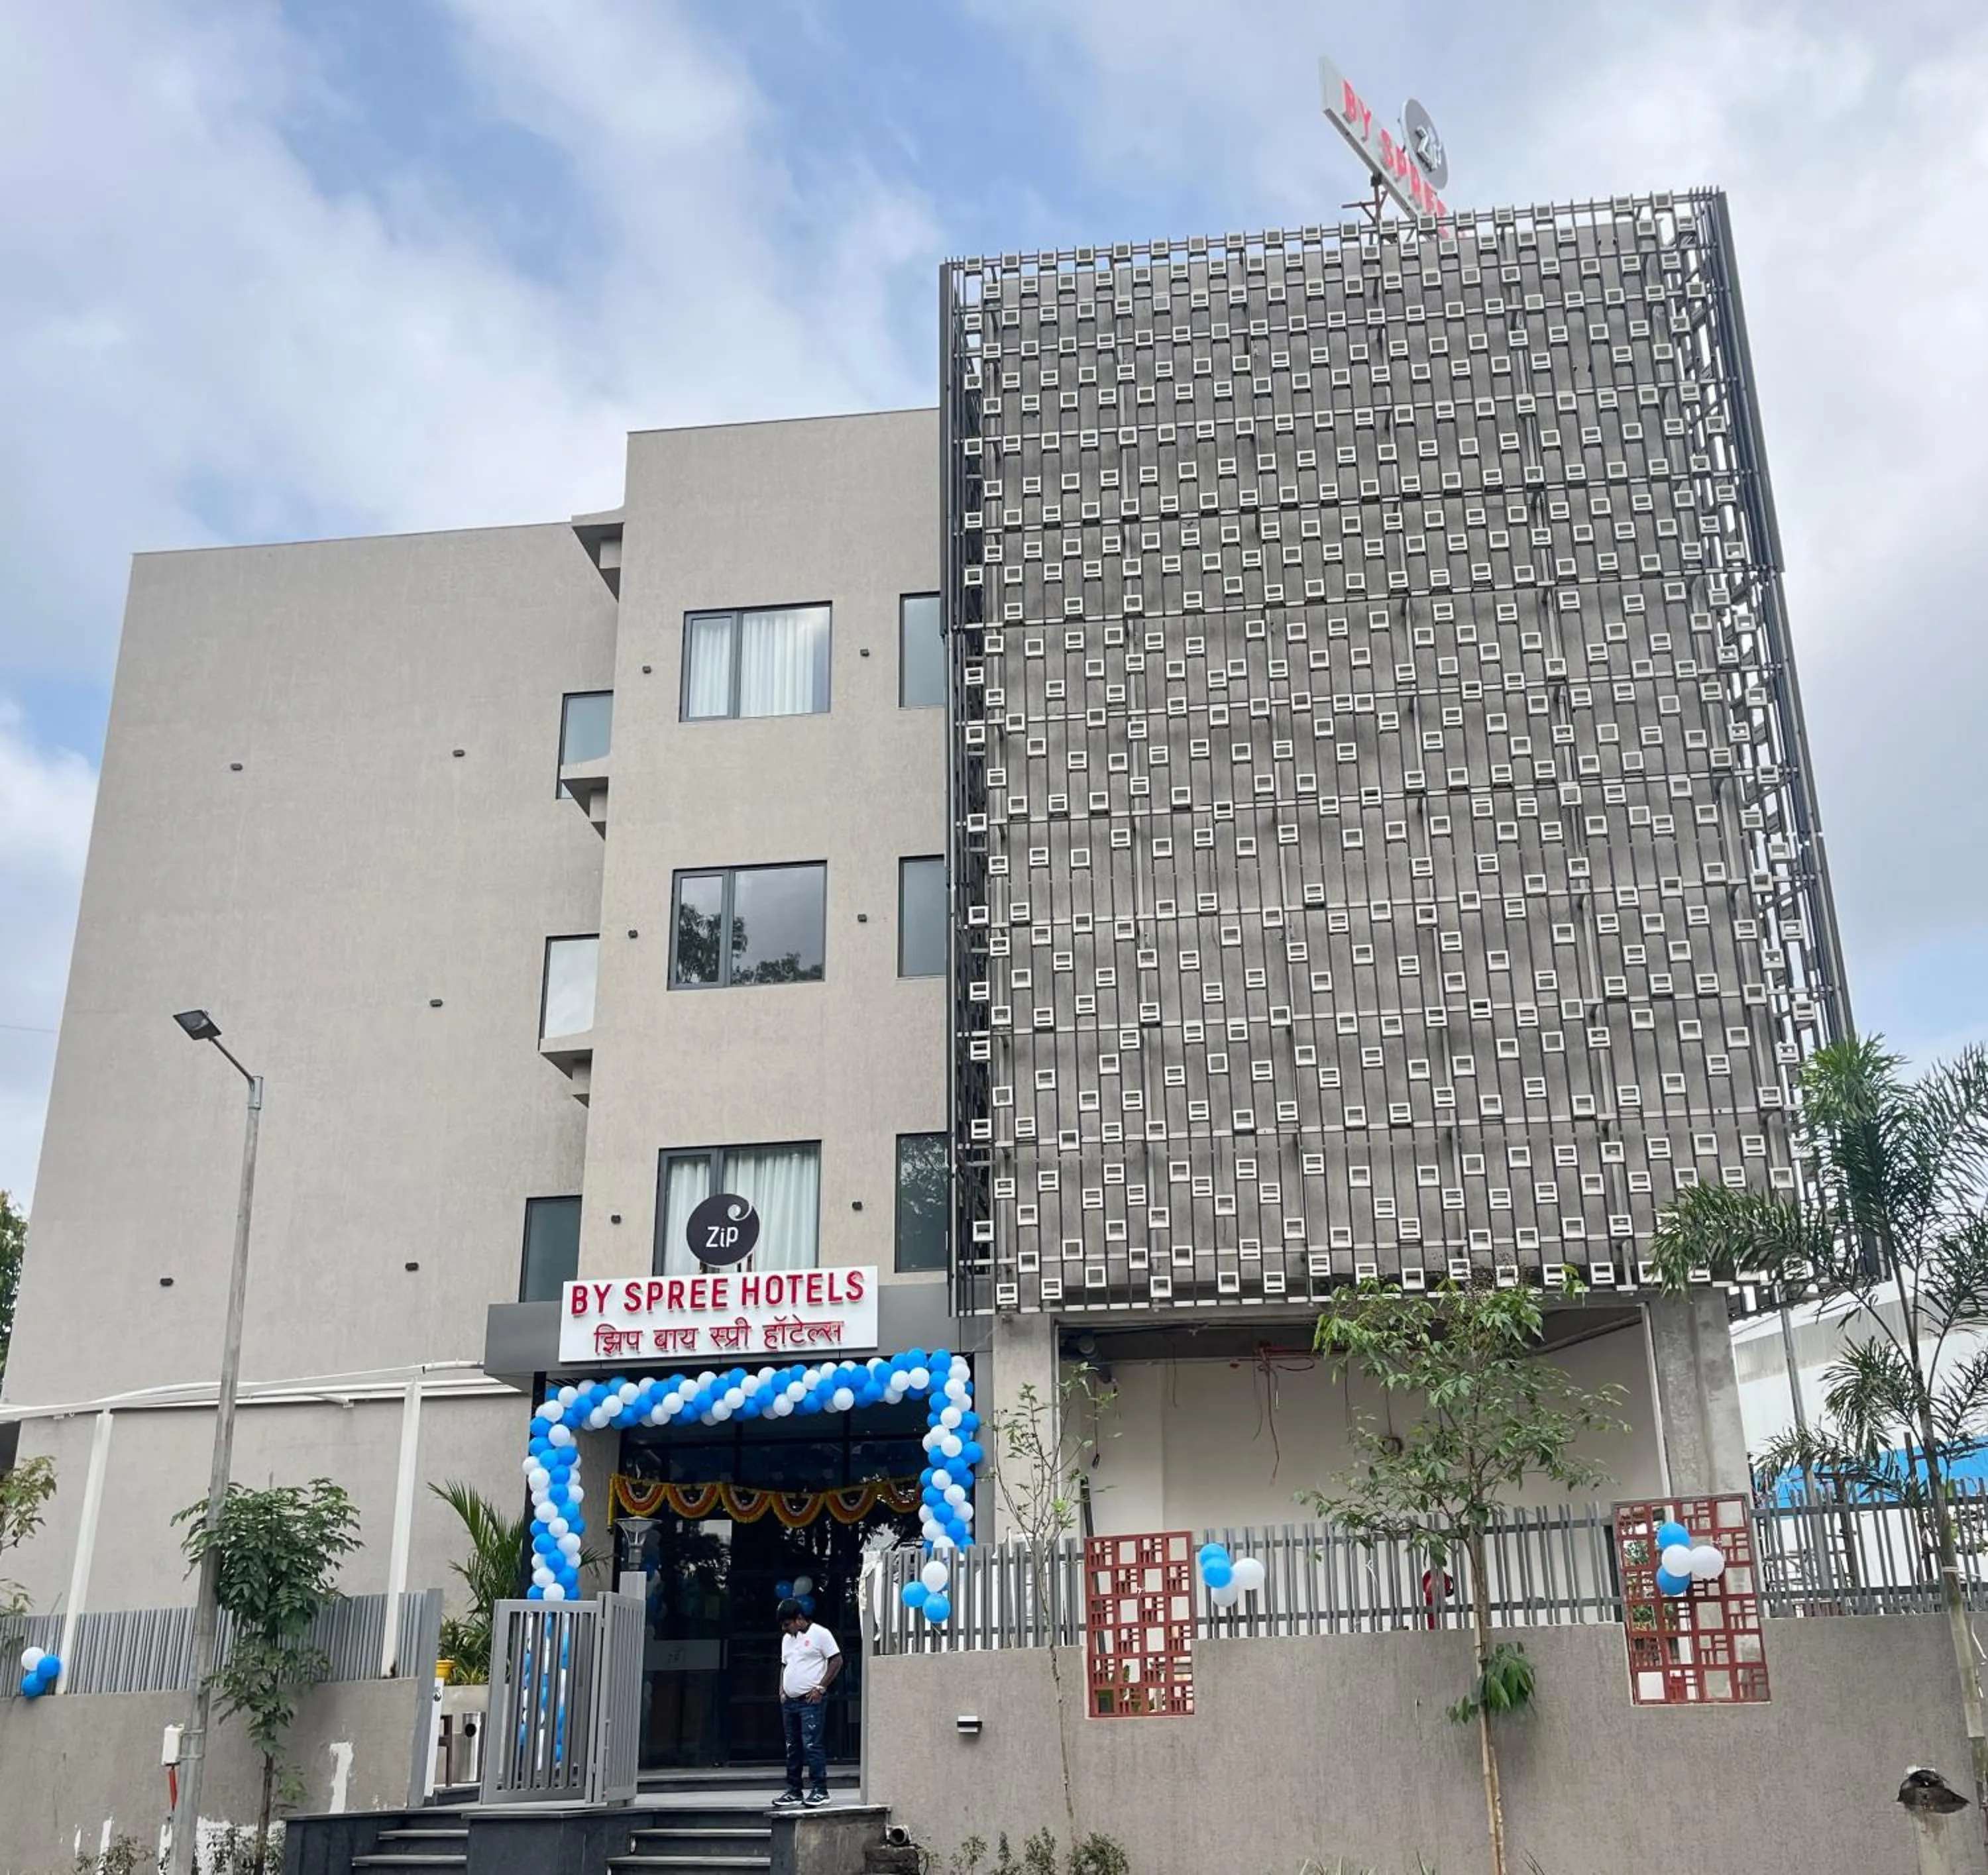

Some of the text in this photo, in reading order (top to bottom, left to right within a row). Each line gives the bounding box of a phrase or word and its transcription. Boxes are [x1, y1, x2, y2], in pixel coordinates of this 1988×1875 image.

[1343, 78, 1372, 142] BY
[571, 1270, 864, 1315] BY SPREE HOTELS
[593, 1314, 845, 1354] झिप बाय स्प्री हॉटेल्स
